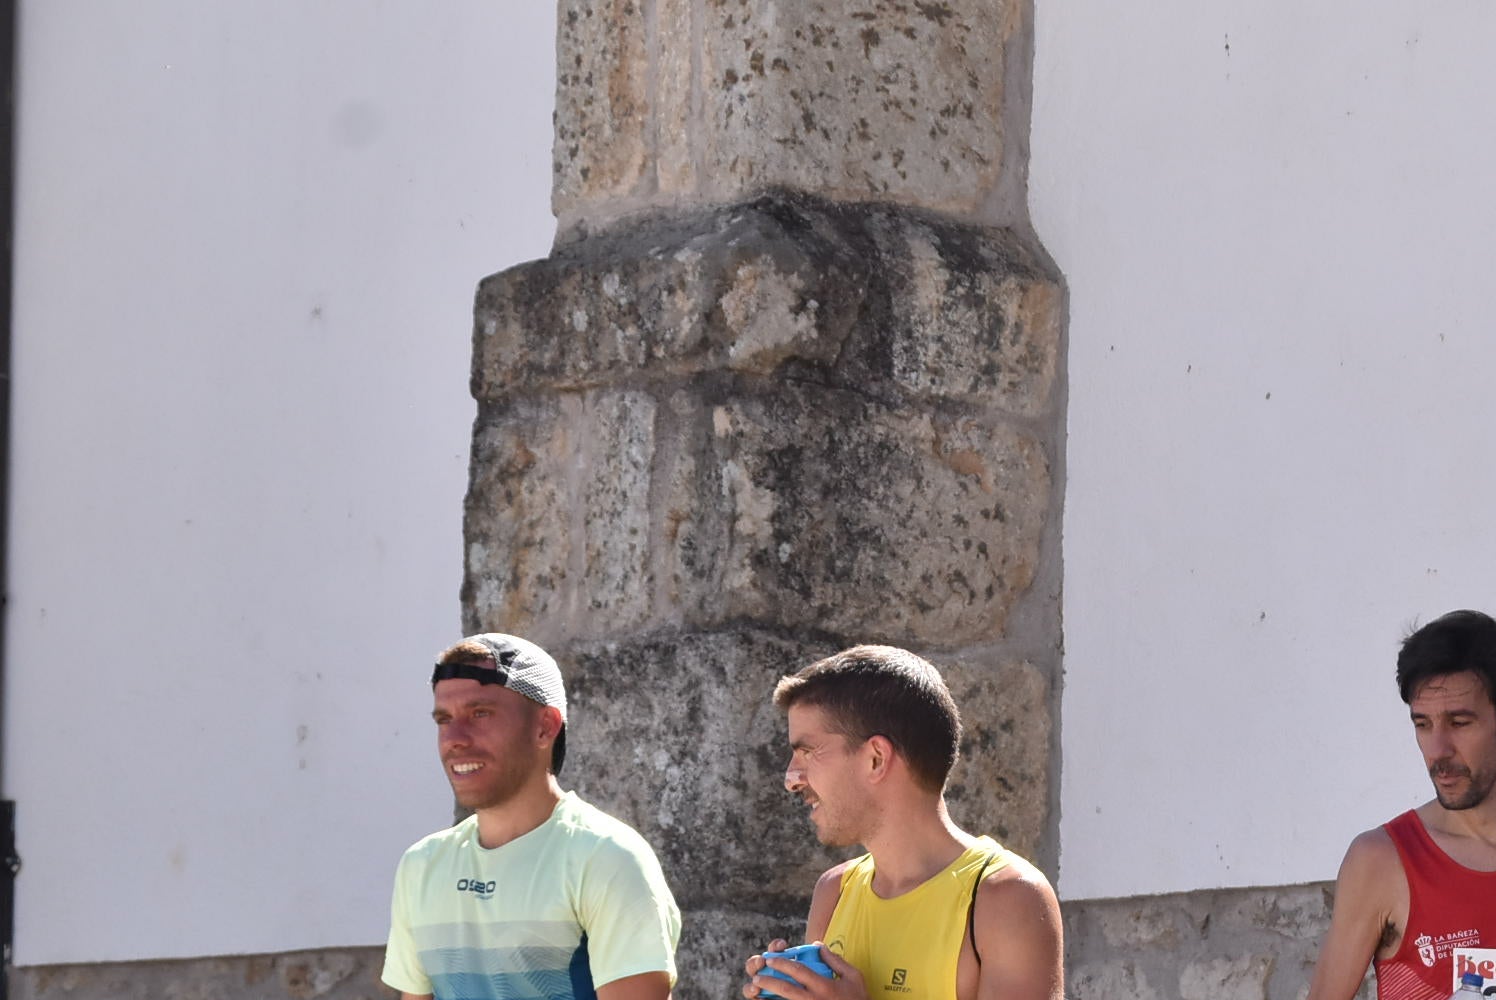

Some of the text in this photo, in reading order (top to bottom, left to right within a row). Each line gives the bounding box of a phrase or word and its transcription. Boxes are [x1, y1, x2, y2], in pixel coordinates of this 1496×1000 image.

[1434, 928, 1479, 944] LA BAÑEZA
[1438, 951, 1449, 960] DE
